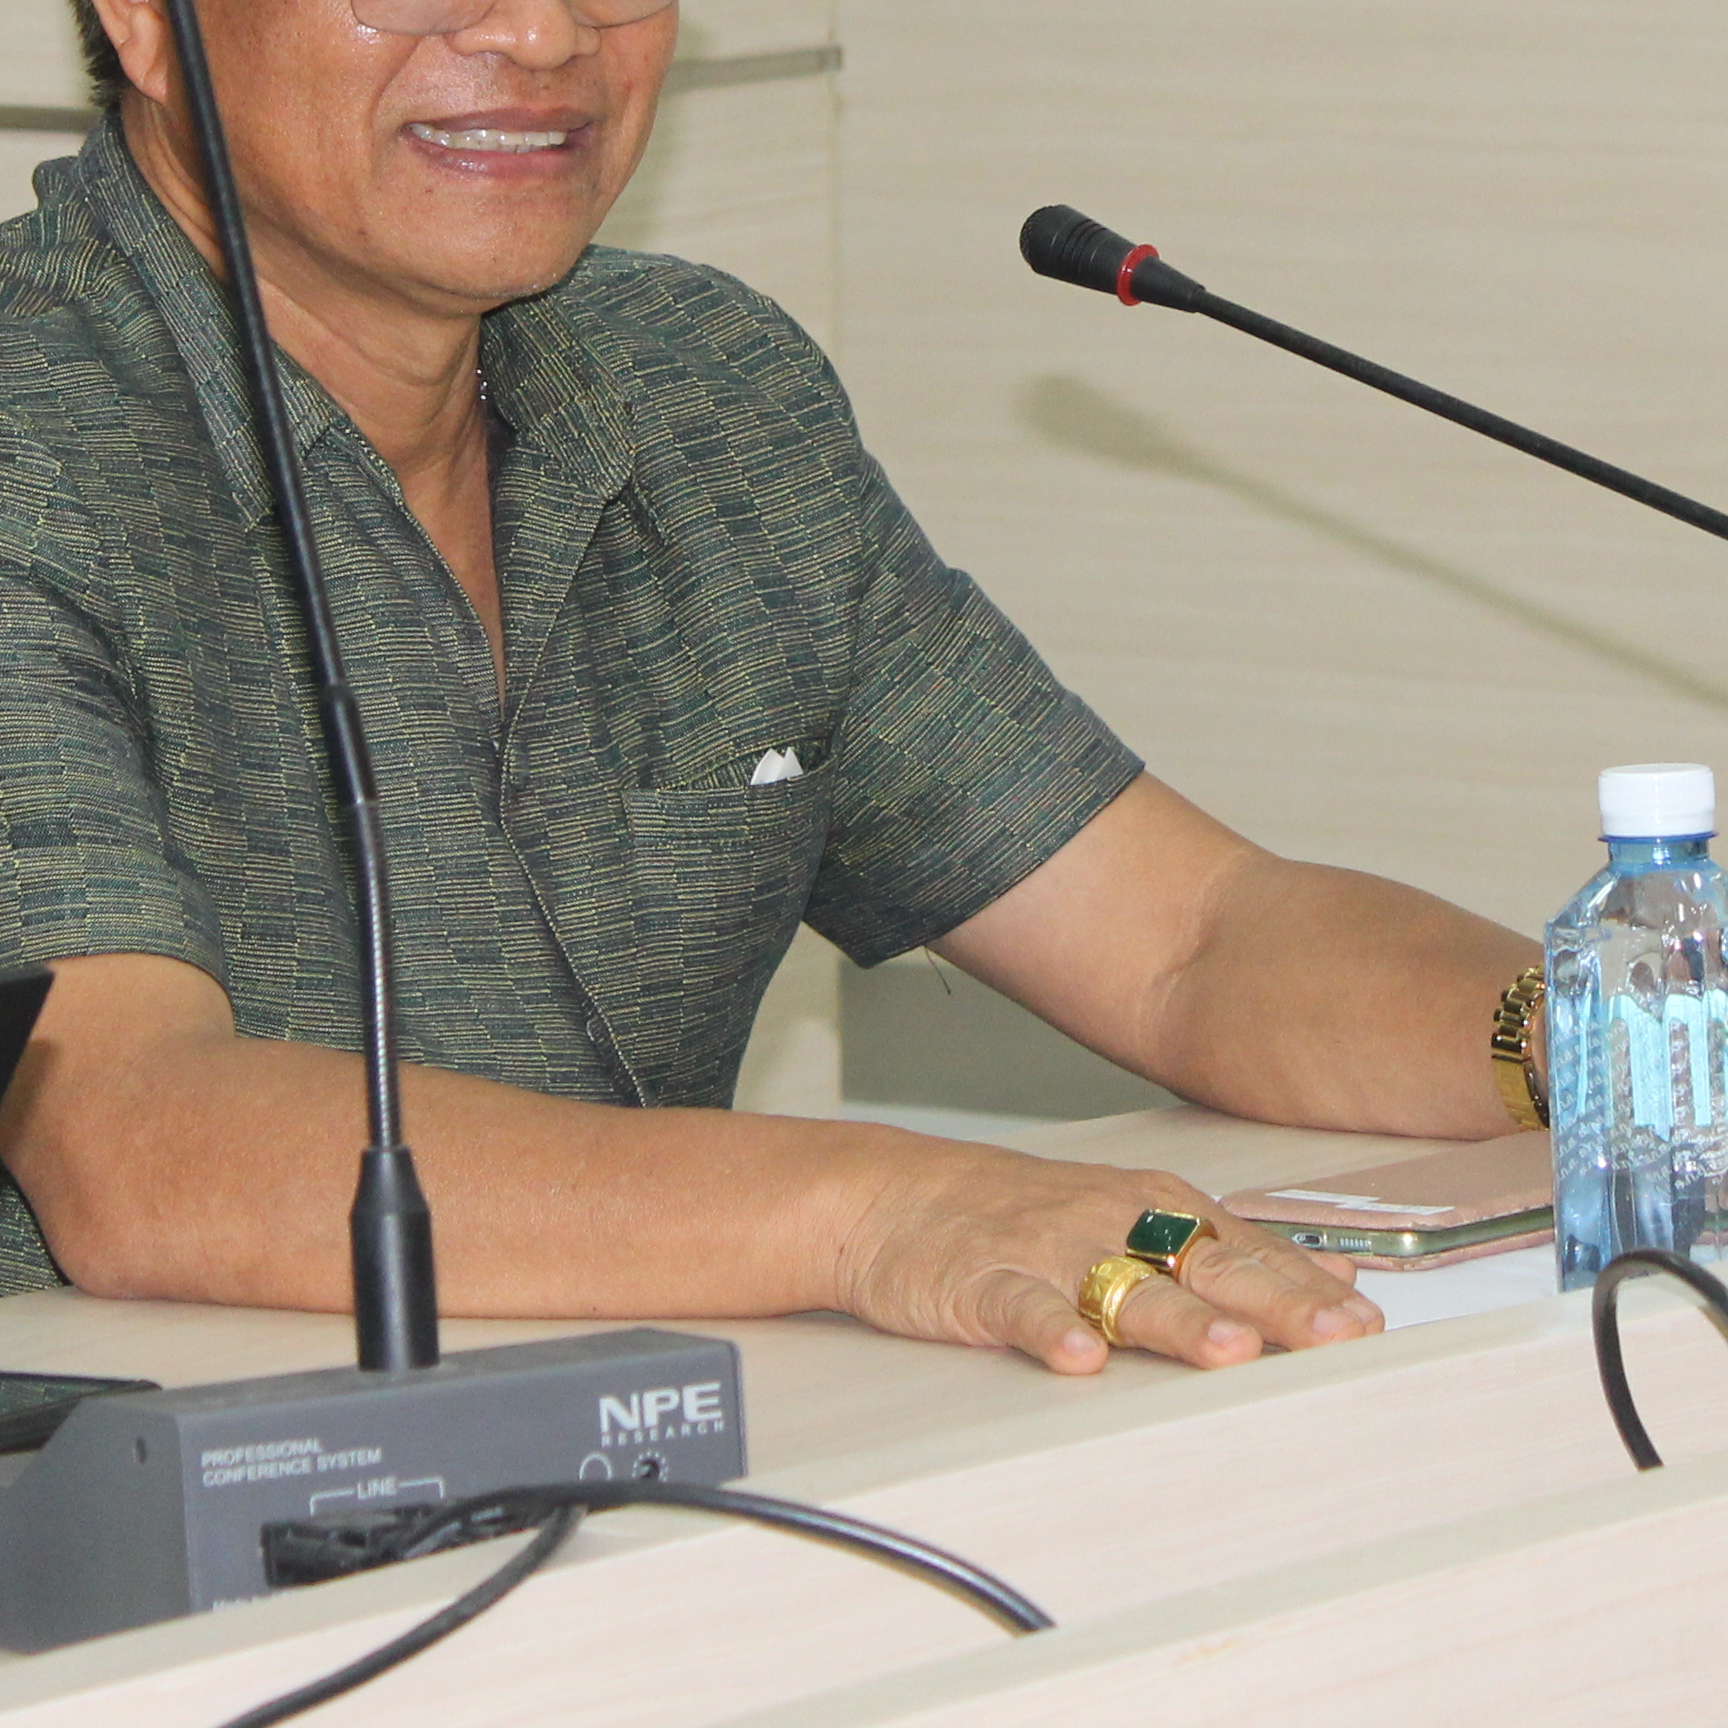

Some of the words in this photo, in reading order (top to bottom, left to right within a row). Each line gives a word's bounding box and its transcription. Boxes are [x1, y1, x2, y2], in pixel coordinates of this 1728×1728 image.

[599, 1381, 722, 1433] NPE
[601, 1419, 725, 1448] RESEARCH
[201, 1438, 323, 1469] PROFESSIONAL
[203, 1456, 313, 1488] CONFERENCE
[317, 1447, 383, 1472] SYSTEM
[357, 1475, 397, 1500] LINE
